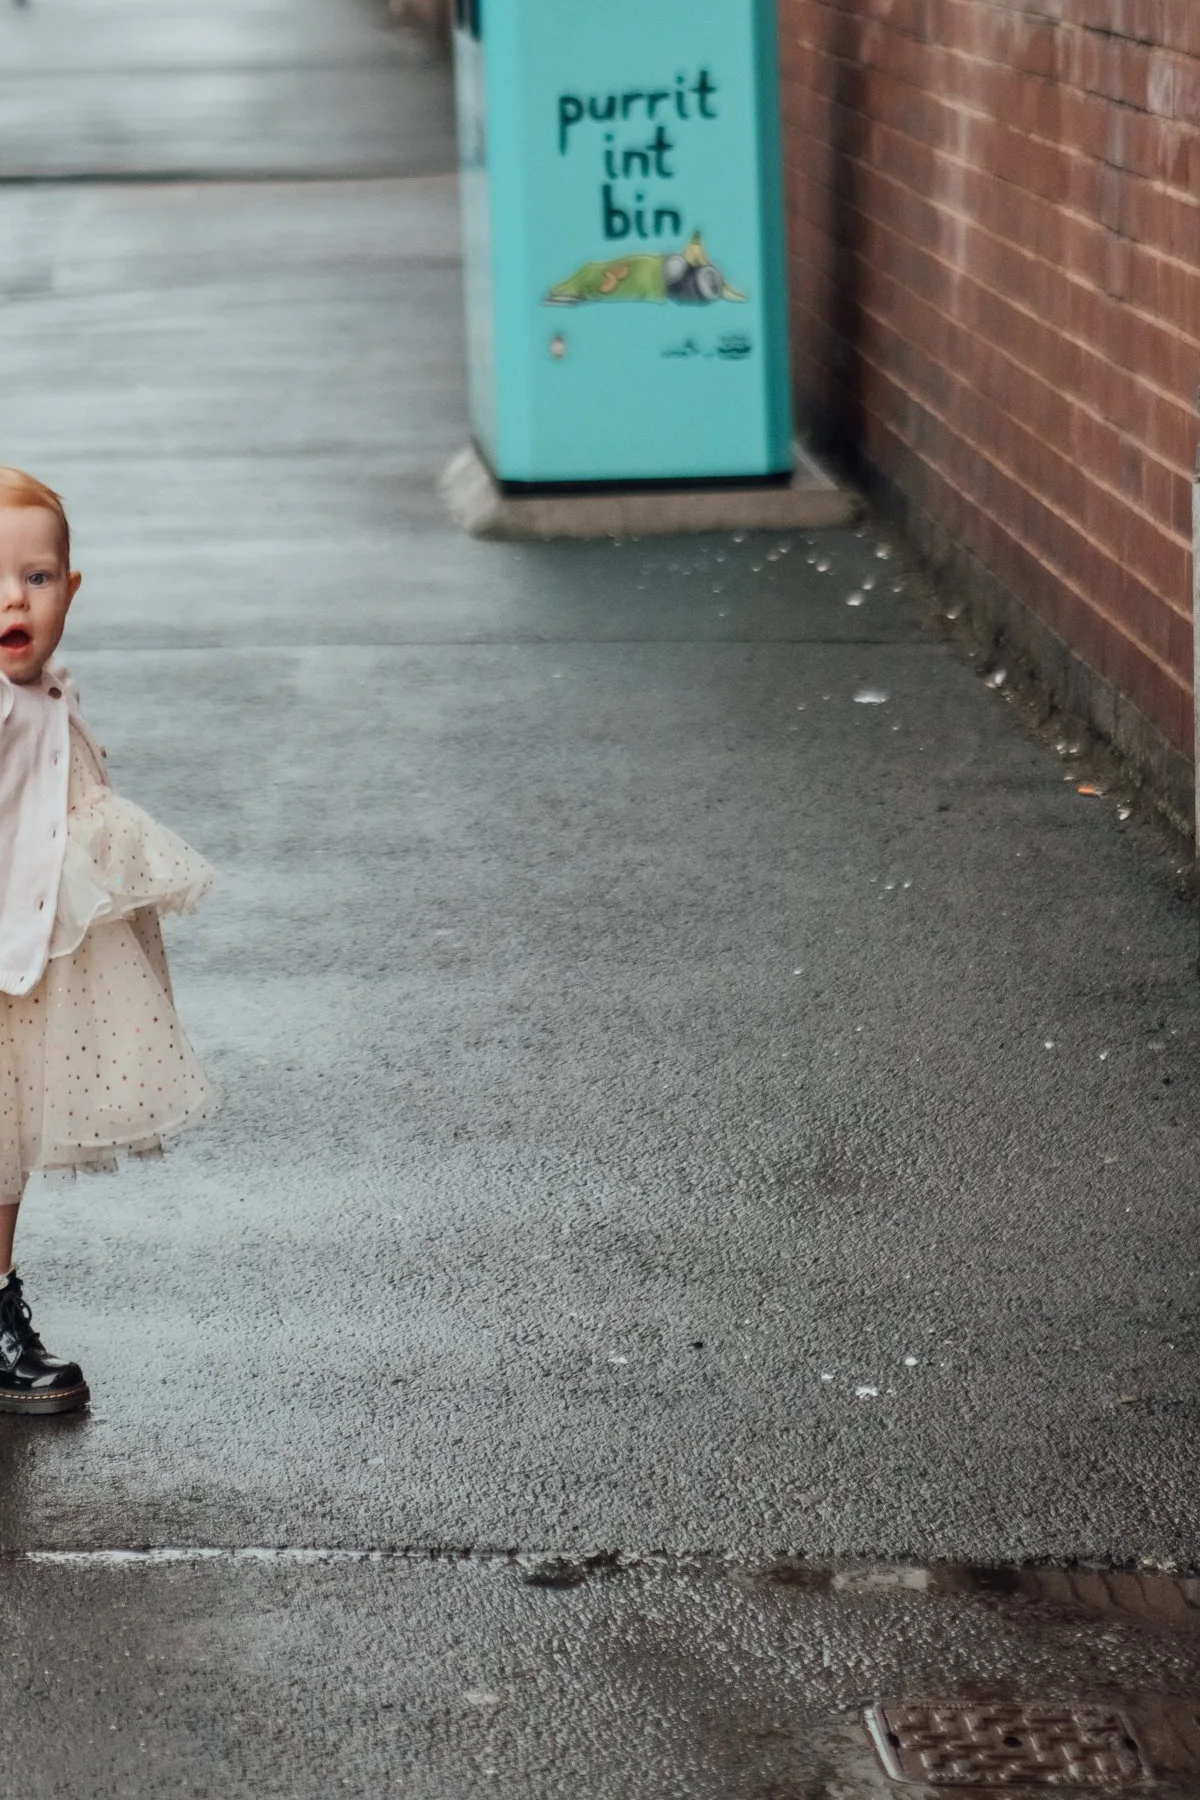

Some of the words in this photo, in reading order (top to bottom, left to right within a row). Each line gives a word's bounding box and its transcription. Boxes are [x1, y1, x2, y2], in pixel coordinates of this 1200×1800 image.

[557, 68, 718, 156] purrit
[603, 125, 675, 180] int
[602, 183, 683, 240] bin
